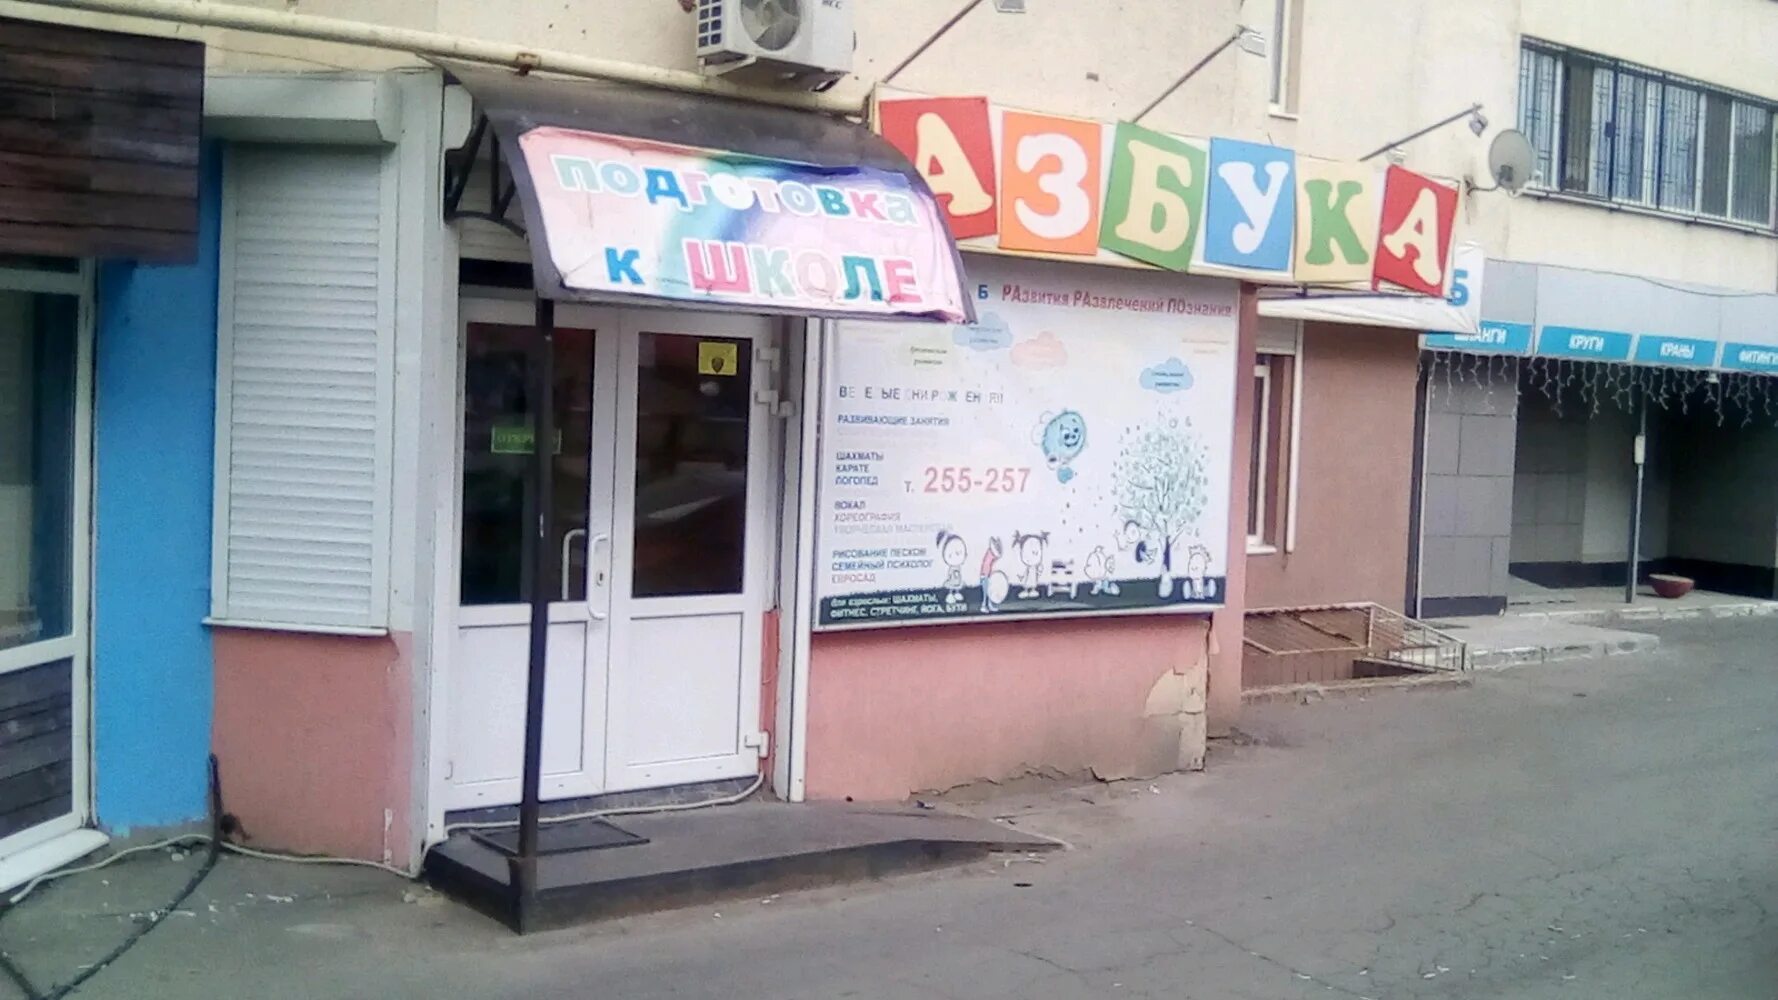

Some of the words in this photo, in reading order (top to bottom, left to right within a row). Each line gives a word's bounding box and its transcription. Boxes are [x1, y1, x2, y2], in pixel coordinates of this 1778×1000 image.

[914, 112, 1445, 284] АЗБУКА
[684, 240, 922, 303] ШКОЛЕ
[1569, 334, 1604, 352] КРУГИ
[1660, 342, 1695, 360] КРАНЫ
[836, 451, 884, 461] ШАХМАТЫ
[835, 464, 869, 474] КАРАТЕ
[835, 475, 879, 486] ЛОГОПЕД
[923, 466, 1032, 494] 255-257
[834, 500, 866, 510] ВОКАЛ
